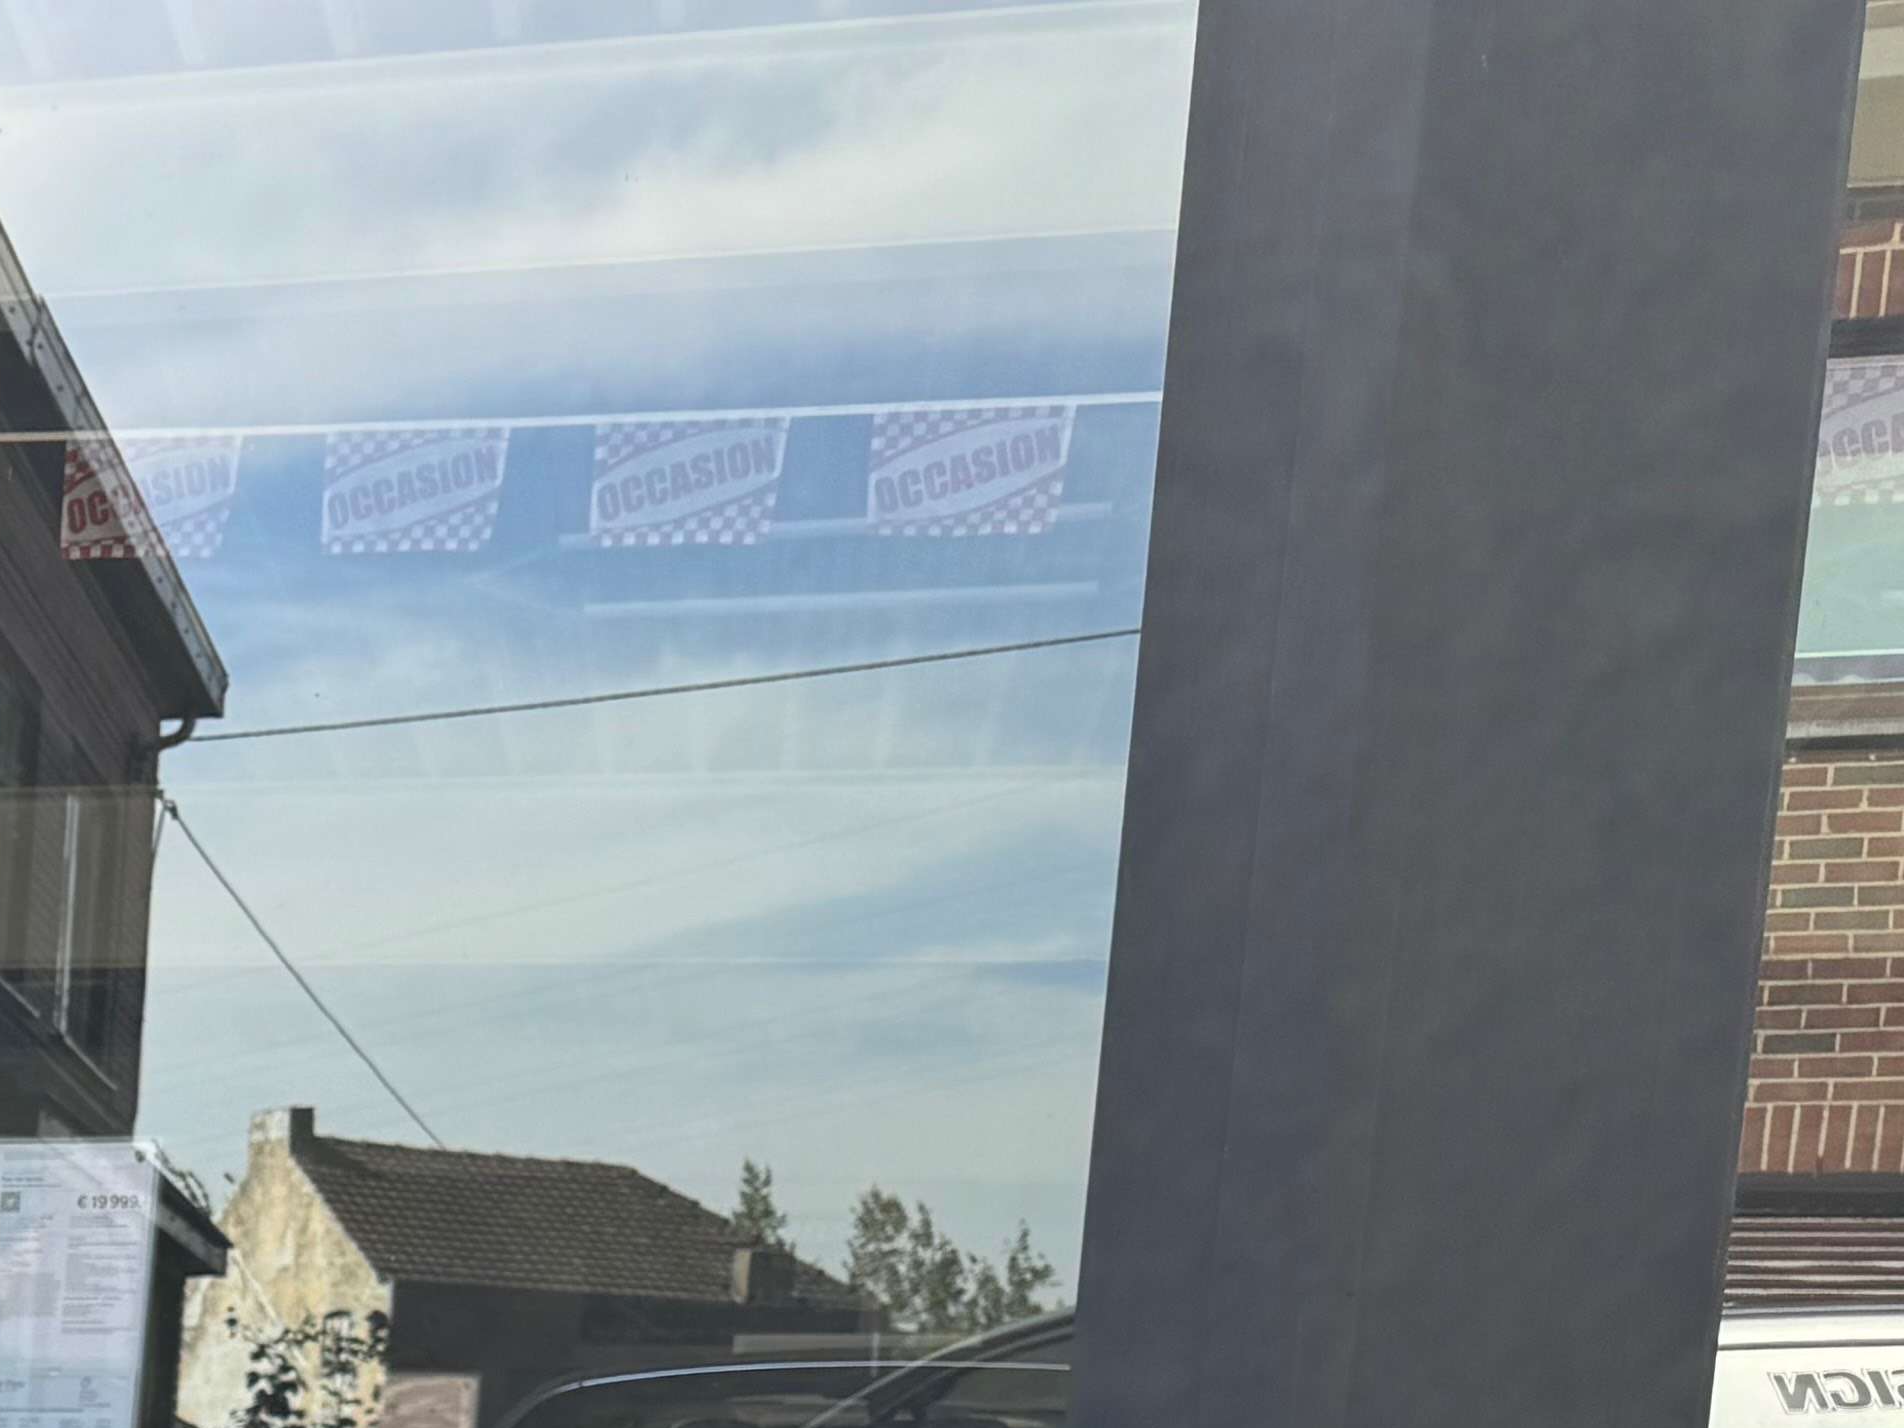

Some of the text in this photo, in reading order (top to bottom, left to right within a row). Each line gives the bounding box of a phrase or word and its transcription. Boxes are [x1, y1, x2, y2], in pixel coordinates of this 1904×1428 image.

[326, 442, 498, 528] OCCASION
[597, 440, 777, 522] OCCASION
[872, 422, 1061, 515] OCCASION
